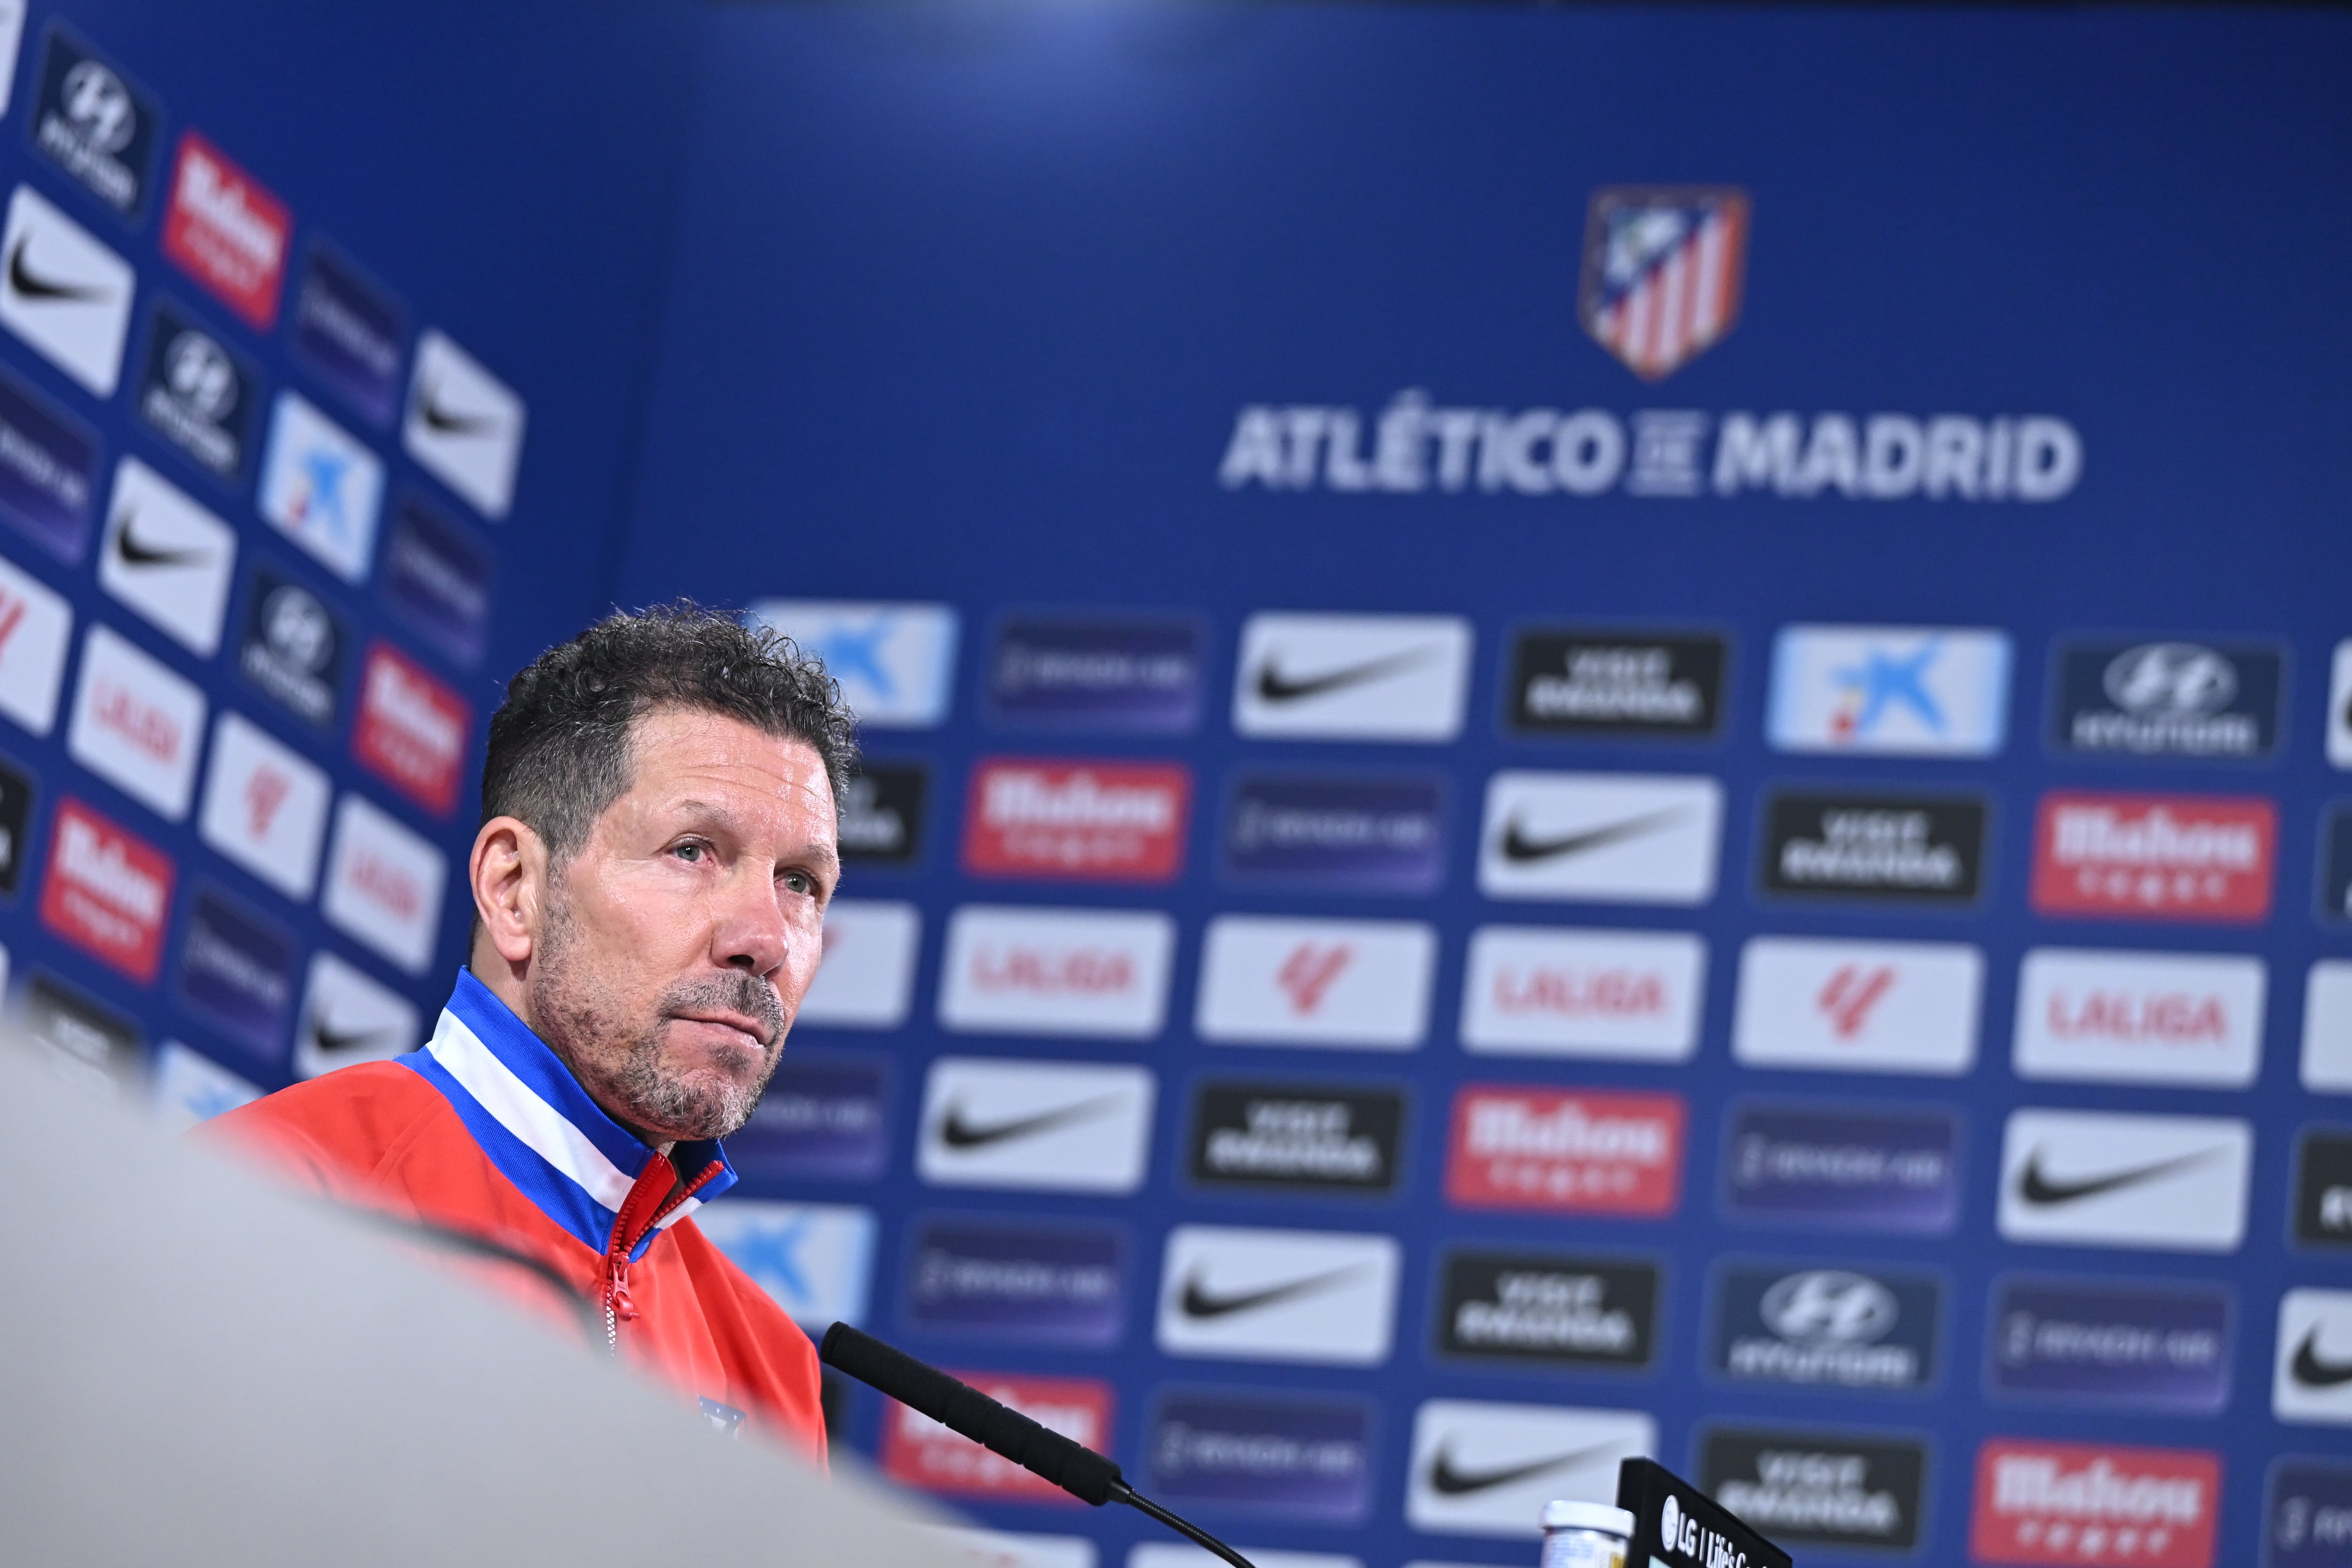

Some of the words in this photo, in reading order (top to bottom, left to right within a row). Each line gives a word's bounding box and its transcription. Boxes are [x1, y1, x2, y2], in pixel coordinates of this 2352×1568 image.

[1222, 390, 1624, 494] ATLÉTICO
[1714, 413, 2081, 501] MADRID
[2053, 806, 2257, 874] Mahou
[972, 949, 1135, 995] LALIGA
[1494, 968, 1667, 1018] LALIGA
[2047, 992, 2228, 1043] LALIGA
[1994, 1455, 2201, 1523] Mahou
[1677, 1512, 1698, 1558] LG
